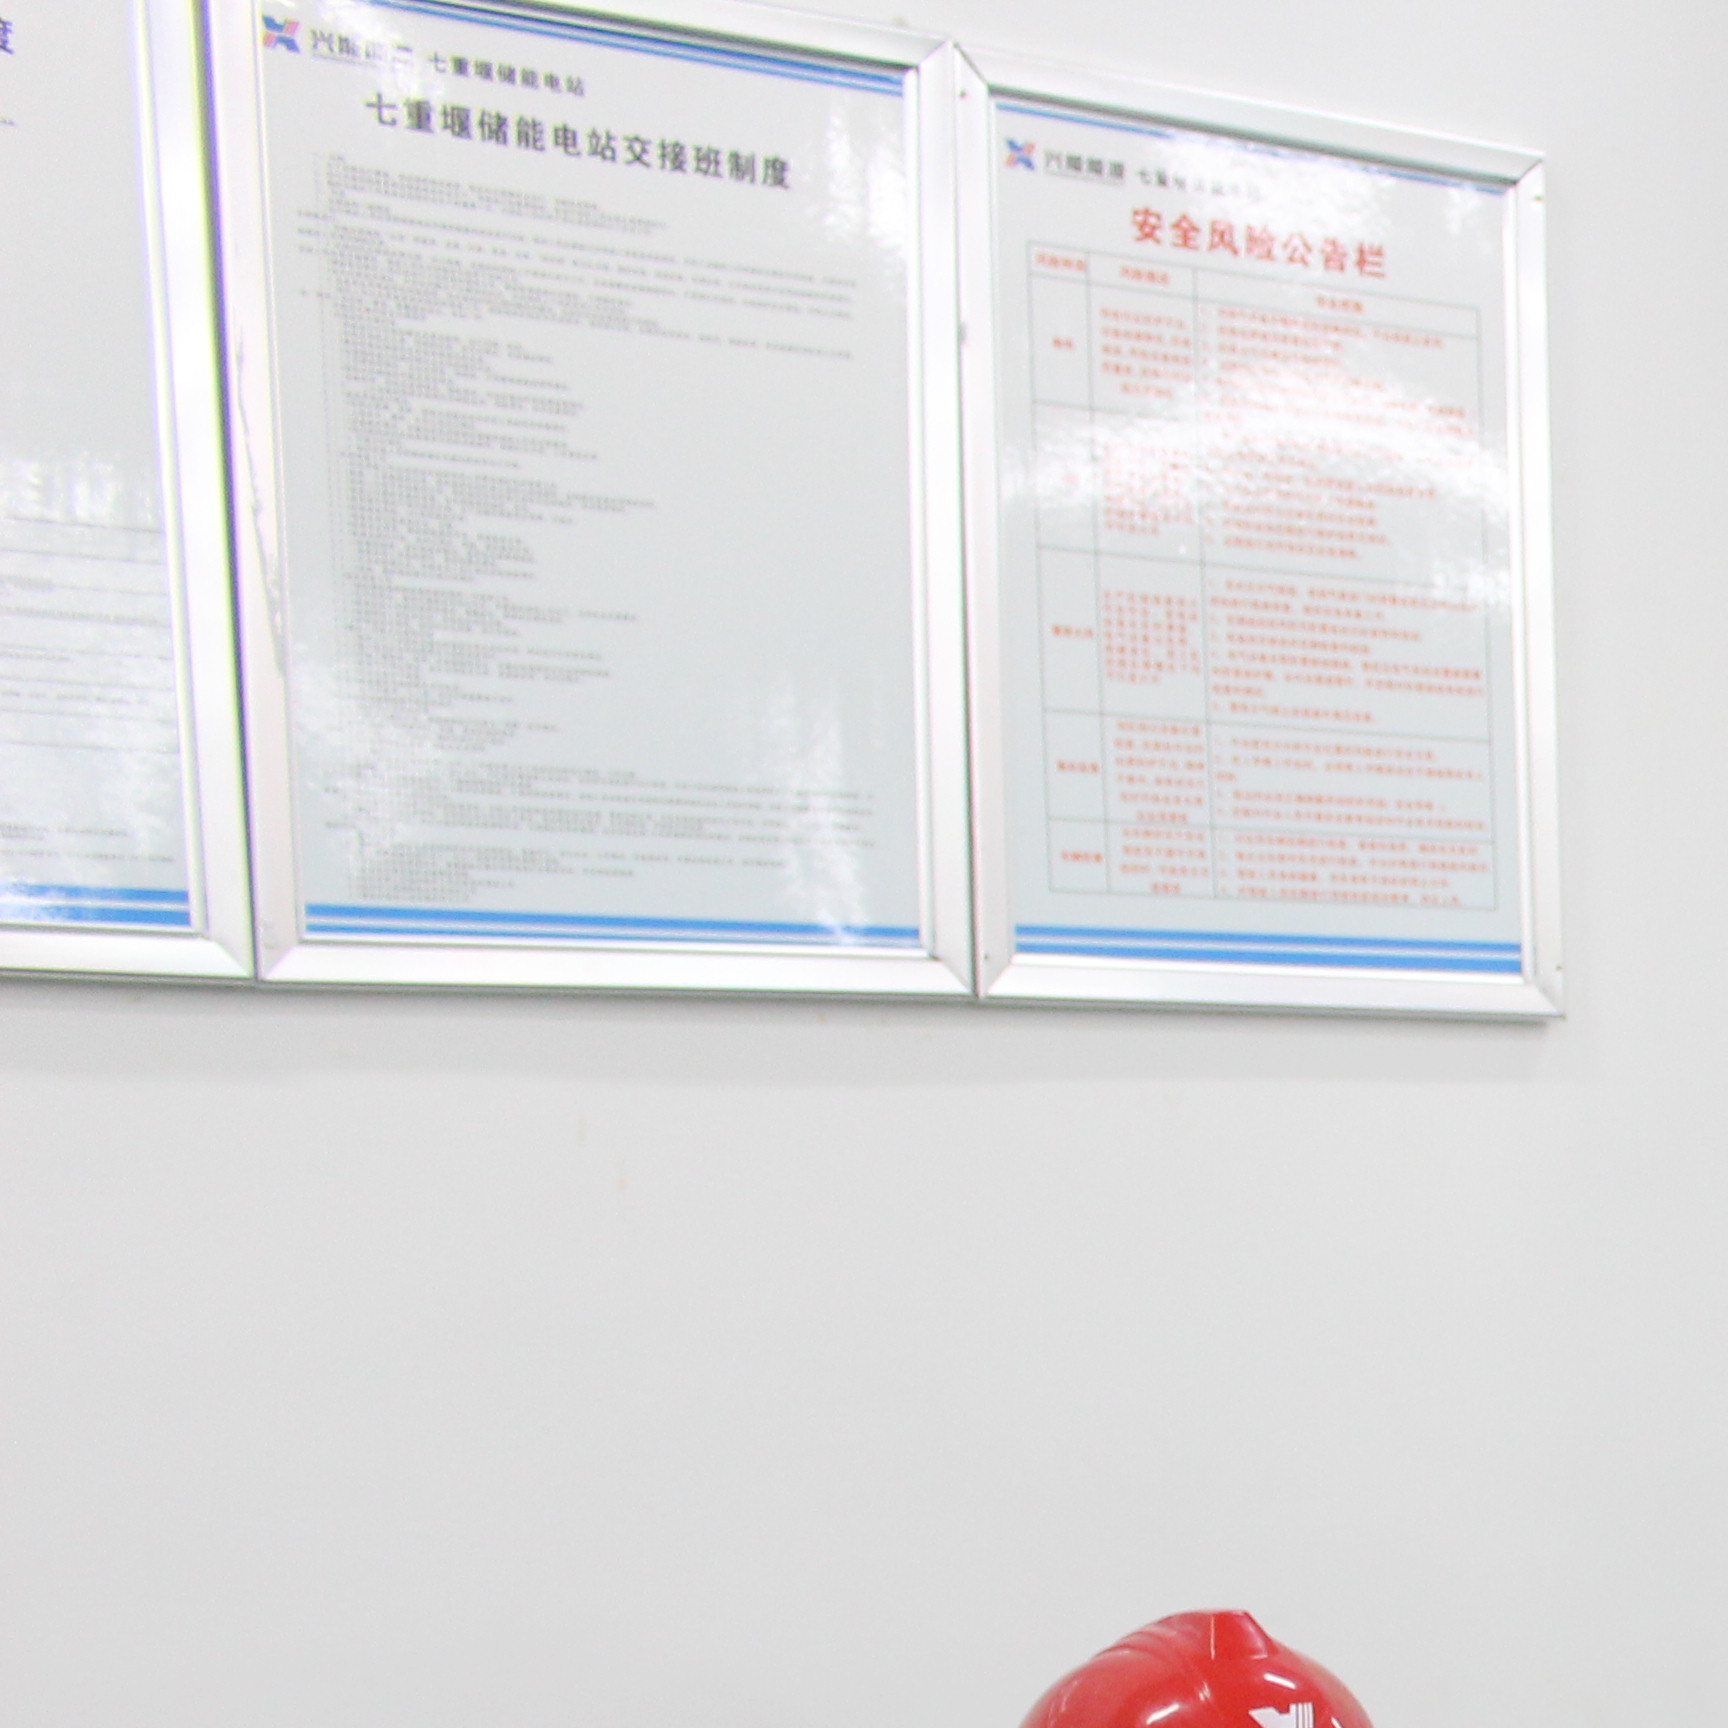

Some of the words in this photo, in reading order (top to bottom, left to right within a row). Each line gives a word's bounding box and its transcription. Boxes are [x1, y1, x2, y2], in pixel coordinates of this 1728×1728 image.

[365, 92, 792, 190] 七重堰储能电站交接班制度
[1131, 206, 1387, 279] 安全风险公告栏
